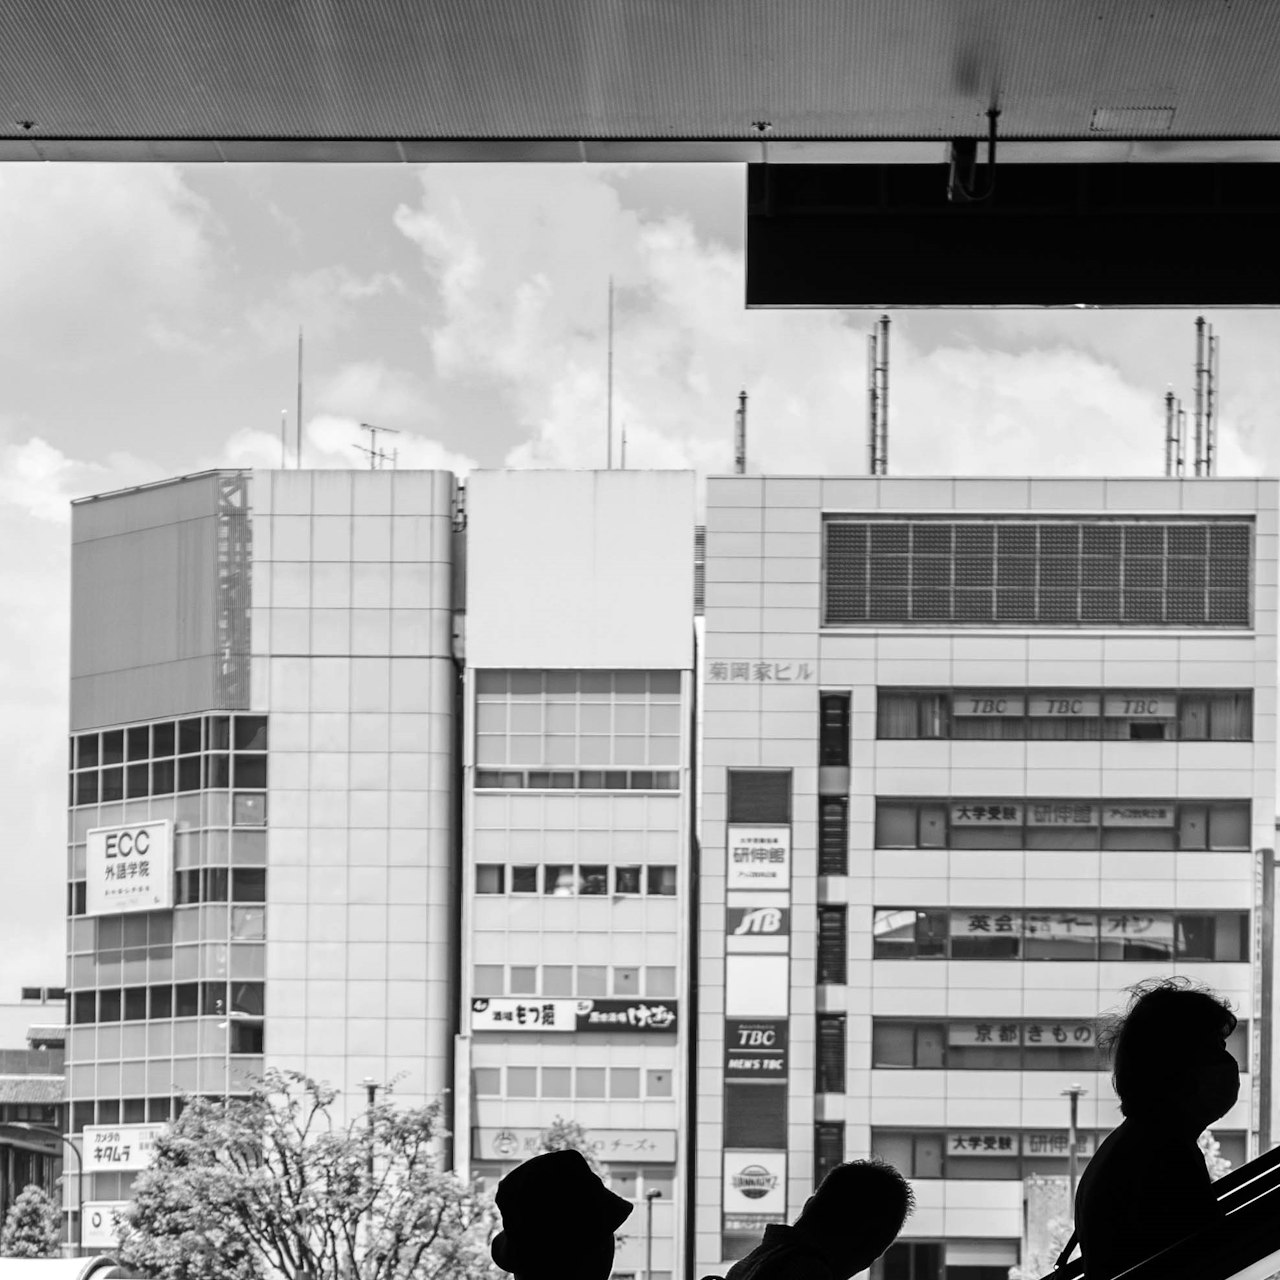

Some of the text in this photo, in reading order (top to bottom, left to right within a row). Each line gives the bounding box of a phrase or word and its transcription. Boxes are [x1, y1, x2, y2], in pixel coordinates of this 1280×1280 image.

[971, 699, 1008, 714] TBC
[1046, 699, 1083, 714] TBC
[1123, 699, 1159, 714] TBC
[956, 806, 1017, 821] 大学受験
[106, 830, 150, 859] ECC
[733, 847, 785, 863] 研伸館
[734, 907, 782, 935] JTB
[738, 1029, 776, 1046] TBC
[974, 1023, 1092, 1043] 京都きもの
[953, 1135, 1013, 1151] 大学受験
[94, 1145, 131, 1162] キタムラ
